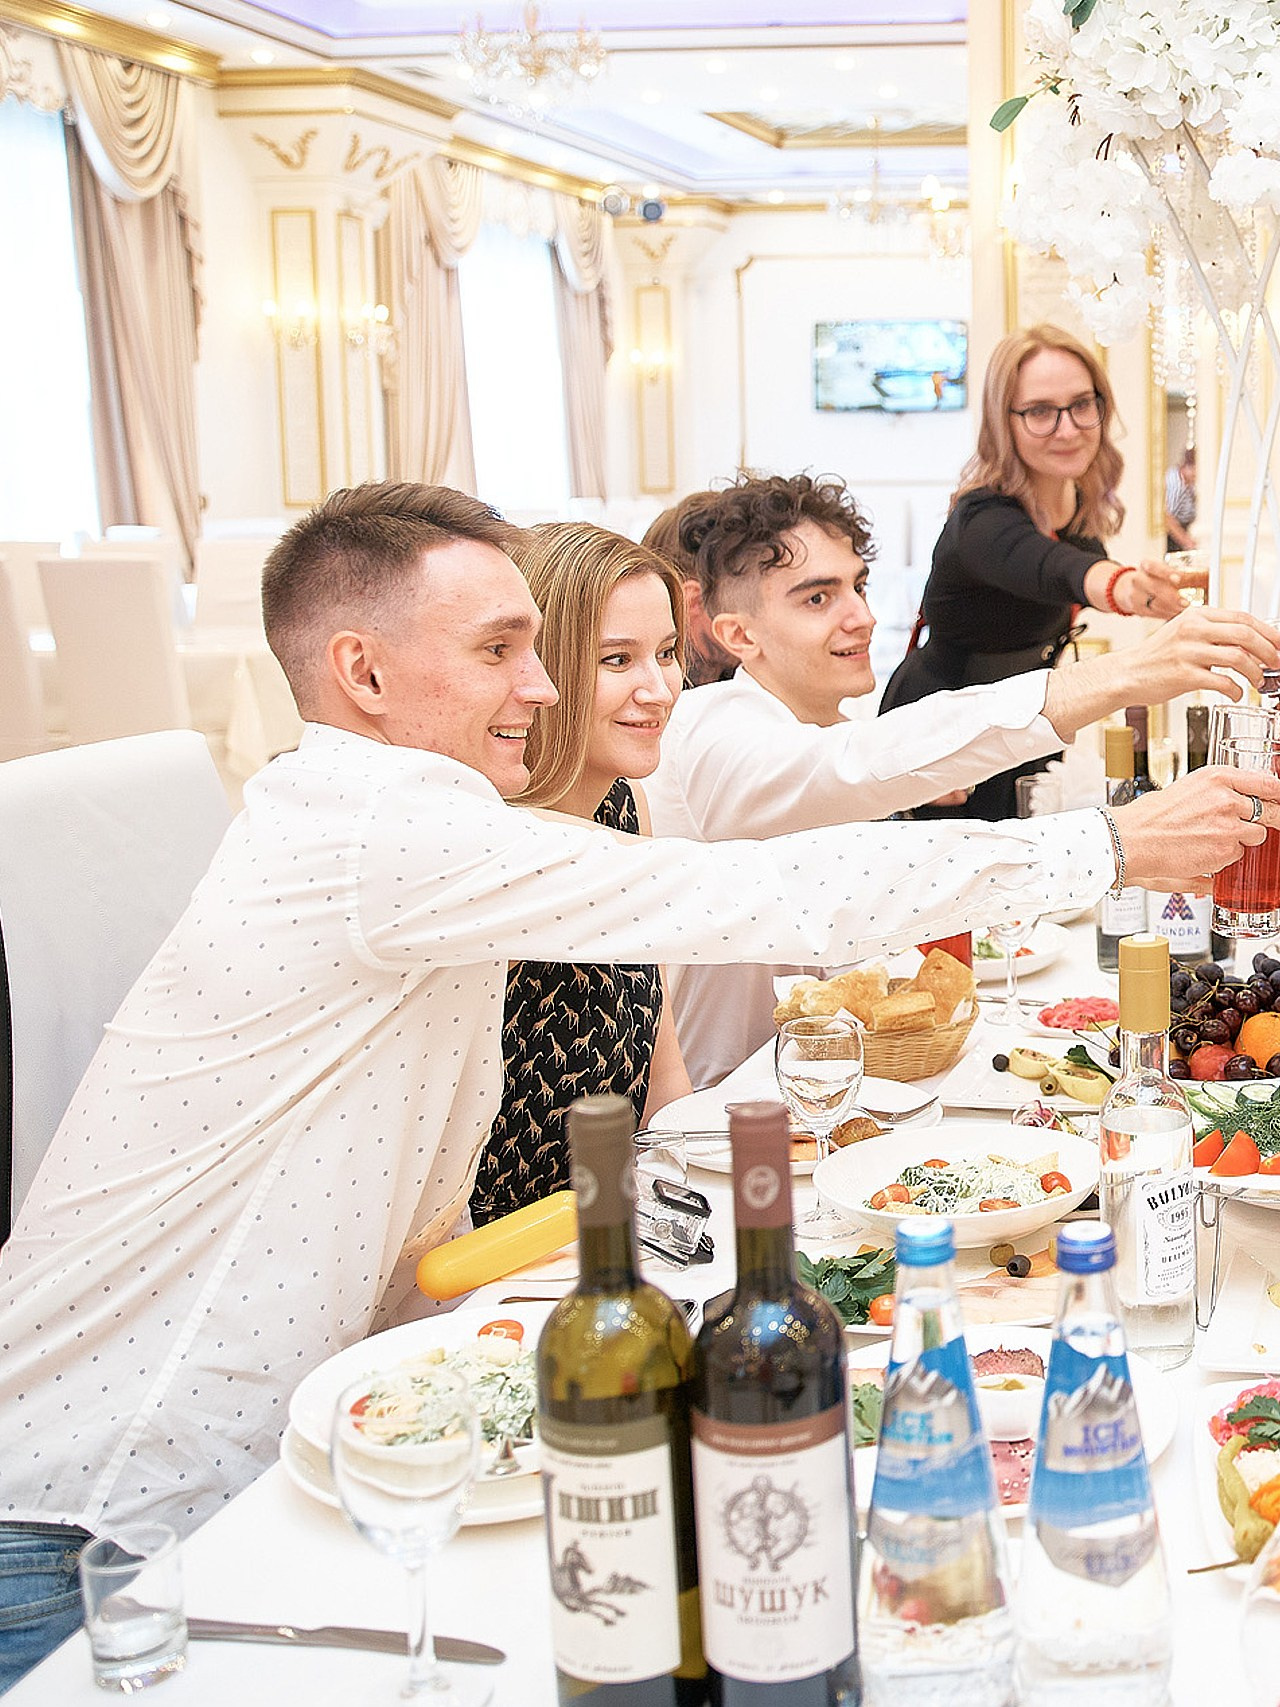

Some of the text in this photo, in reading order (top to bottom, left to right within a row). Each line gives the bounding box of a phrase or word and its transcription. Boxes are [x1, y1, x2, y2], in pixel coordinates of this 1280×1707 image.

[1156, 925, 1201, 937] TUNDRA
[889, 1408, 934, 1432] ICE
[1081, 1418, 1126, 1444] ICE
[714, 1576, 831, 1613] ШУШУК
